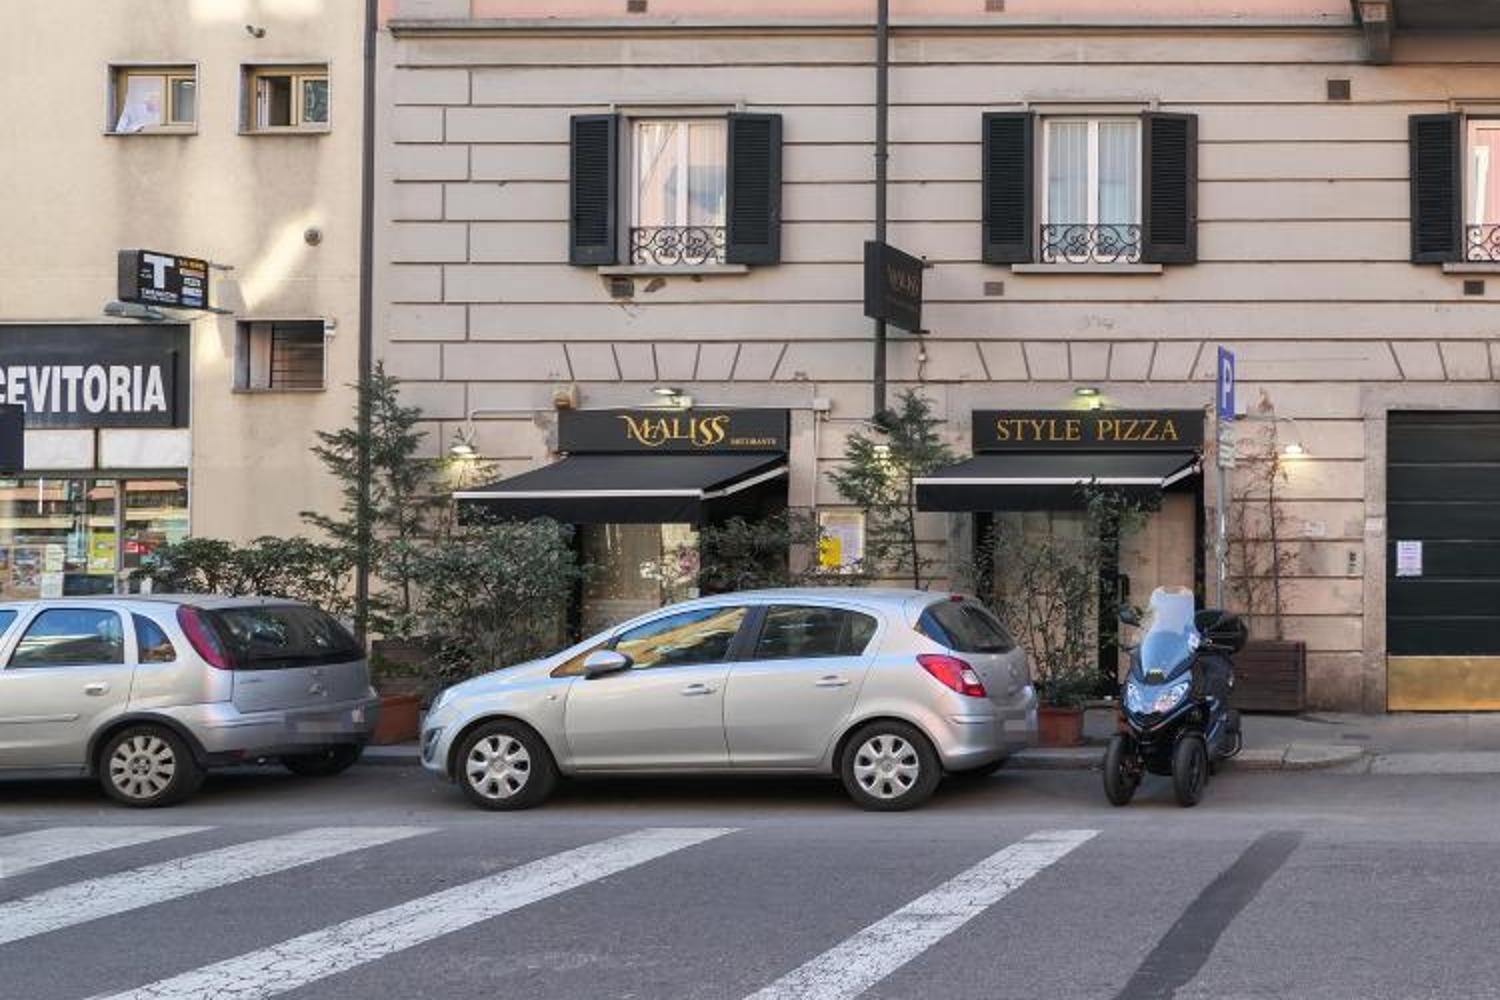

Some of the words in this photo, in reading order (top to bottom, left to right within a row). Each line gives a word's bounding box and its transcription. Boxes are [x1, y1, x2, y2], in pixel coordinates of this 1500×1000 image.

[143, 253, 175, 289] T
[0, 365, 167, 413] EVITORIA
[1222, 358, 1233, 409] P
[997, 419, 1081, 441] STYLE
[1097, 419, 1180, 441] PIZZA
